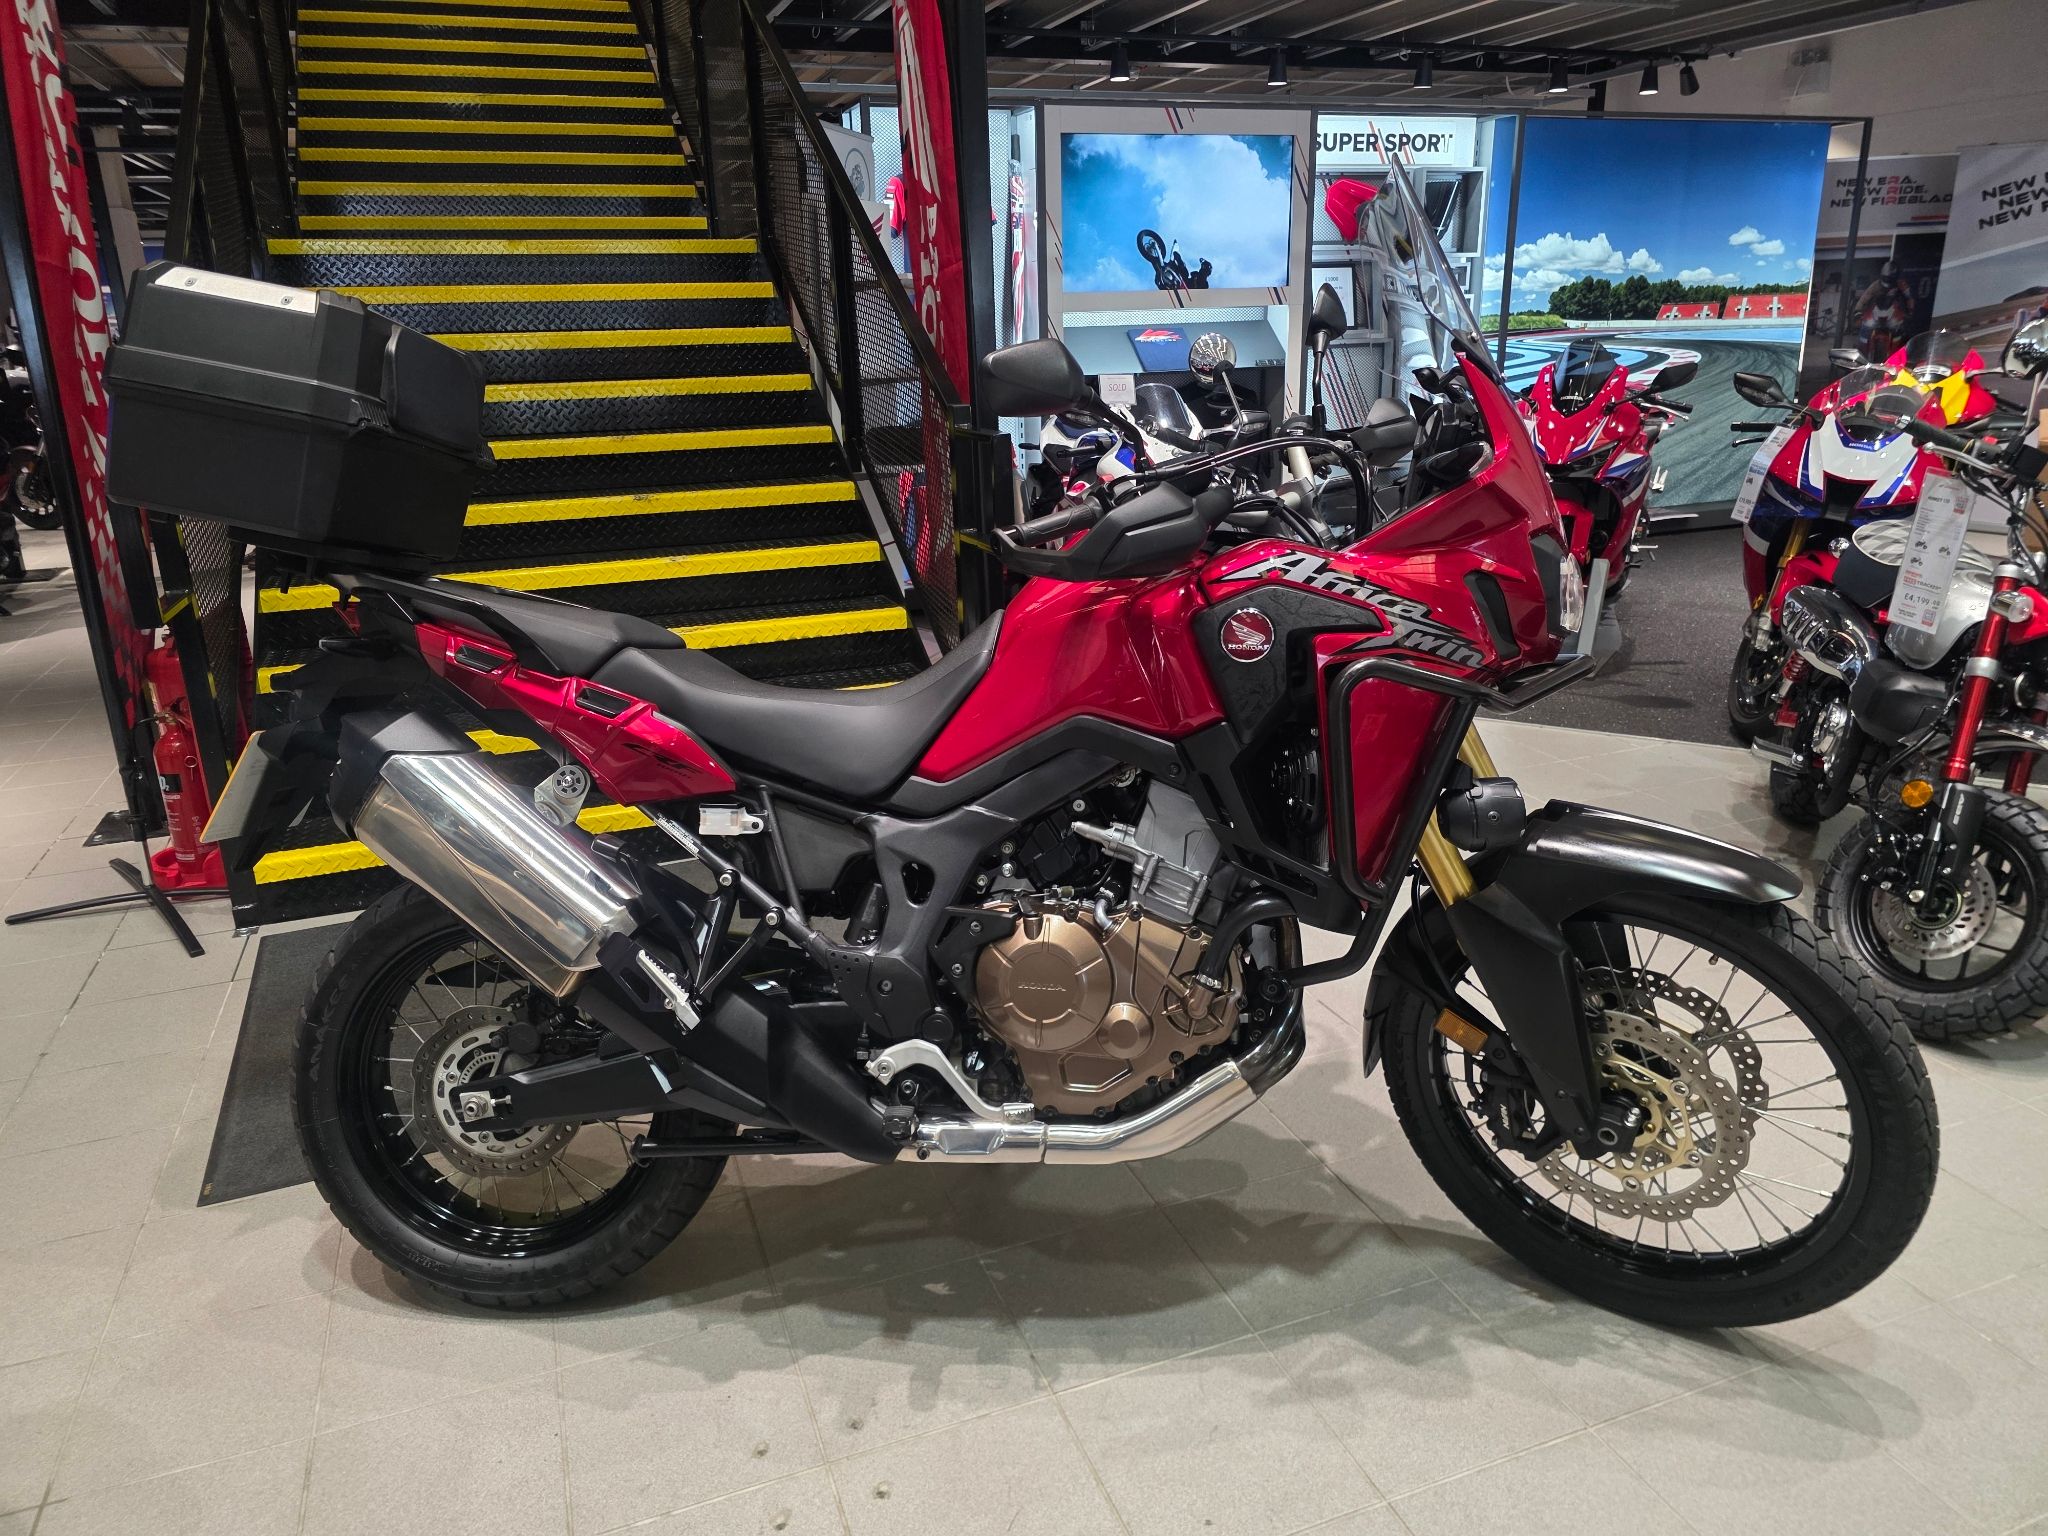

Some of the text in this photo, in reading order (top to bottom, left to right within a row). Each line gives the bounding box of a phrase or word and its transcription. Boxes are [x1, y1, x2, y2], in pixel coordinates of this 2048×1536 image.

[1314, 132, 1453, 153] SUPER SPORT
[1981, 174, 2038, 202] NEW
[1978, 204, 2034, 230] NEW
[1108, 383, 1127, 392] SOLD
[1221, 551, 1431, 621] Africa
[1227, 643, 1270, 652] HONDA
[1352, 612, 1484, 669] Twin
[1017, 980, 1067, 992] HONDA
